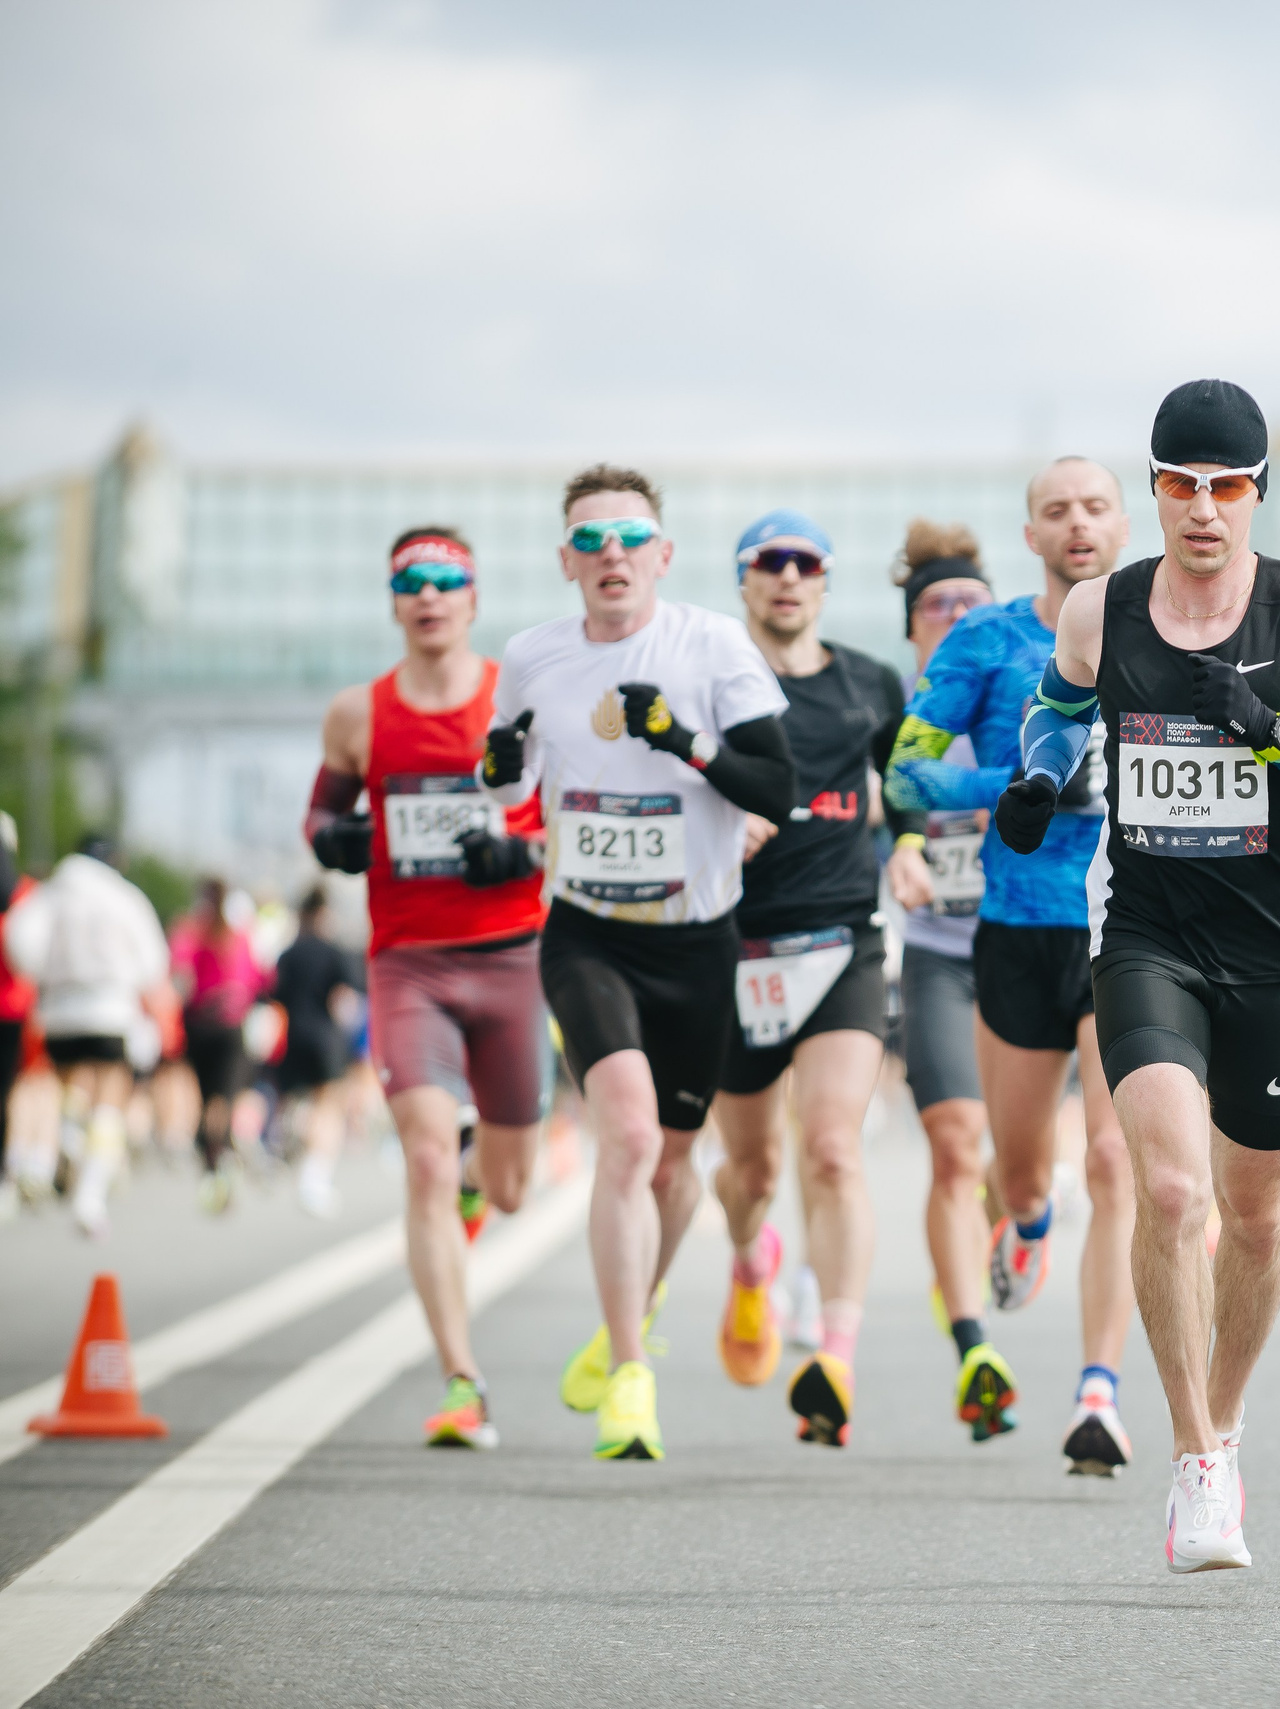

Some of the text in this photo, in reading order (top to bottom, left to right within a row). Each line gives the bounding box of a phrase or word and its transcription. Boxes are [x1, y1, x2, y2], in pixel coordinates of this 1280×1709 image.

[1130, 757, 1259, 800] 10315
[1168, 805, 1211, 816] АРТЕМ
[578, 825, 665, 857] 8213
